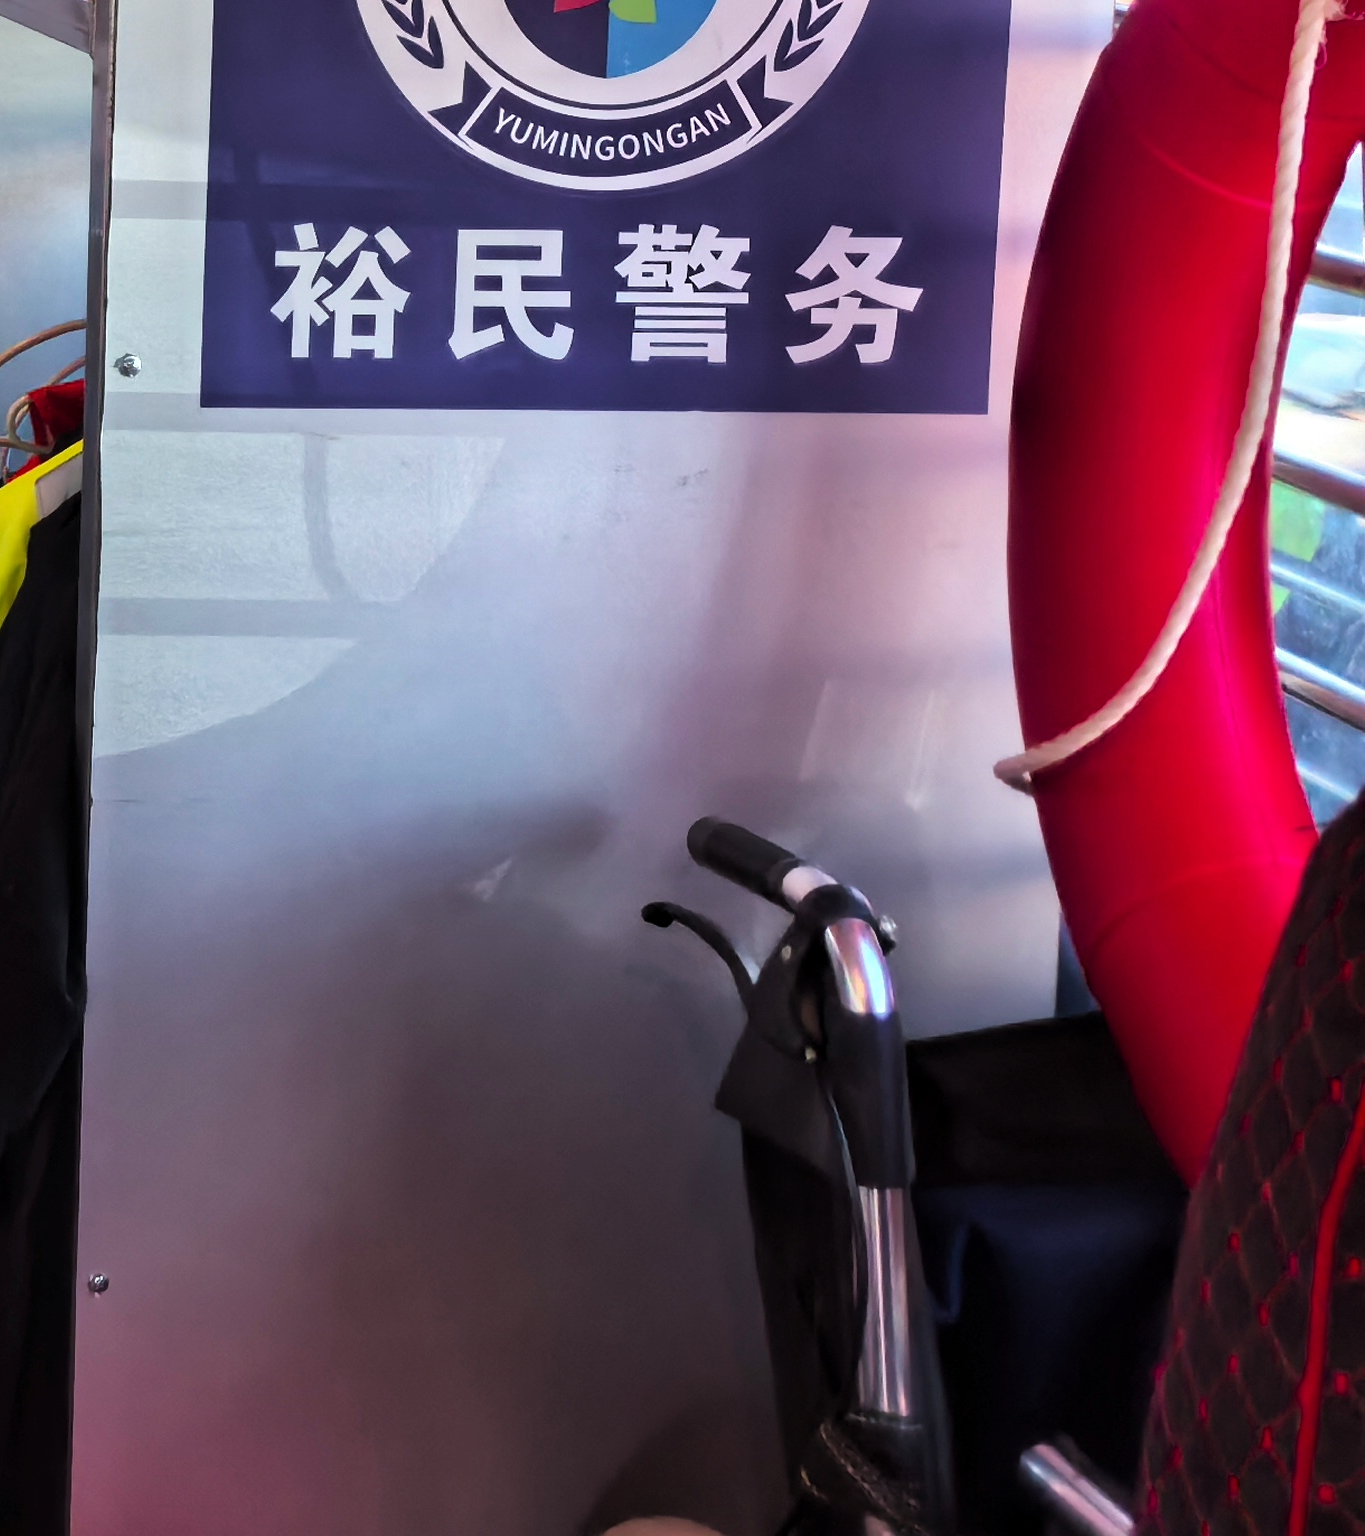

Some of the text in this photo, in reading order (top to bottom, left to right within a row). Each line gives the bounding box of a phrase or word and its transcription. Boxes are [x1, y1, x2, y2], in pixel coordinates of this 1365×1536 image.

[493, 101, 733, 162] YUMINGONGAN
[269, 222, 925, 365] 裕民警务
